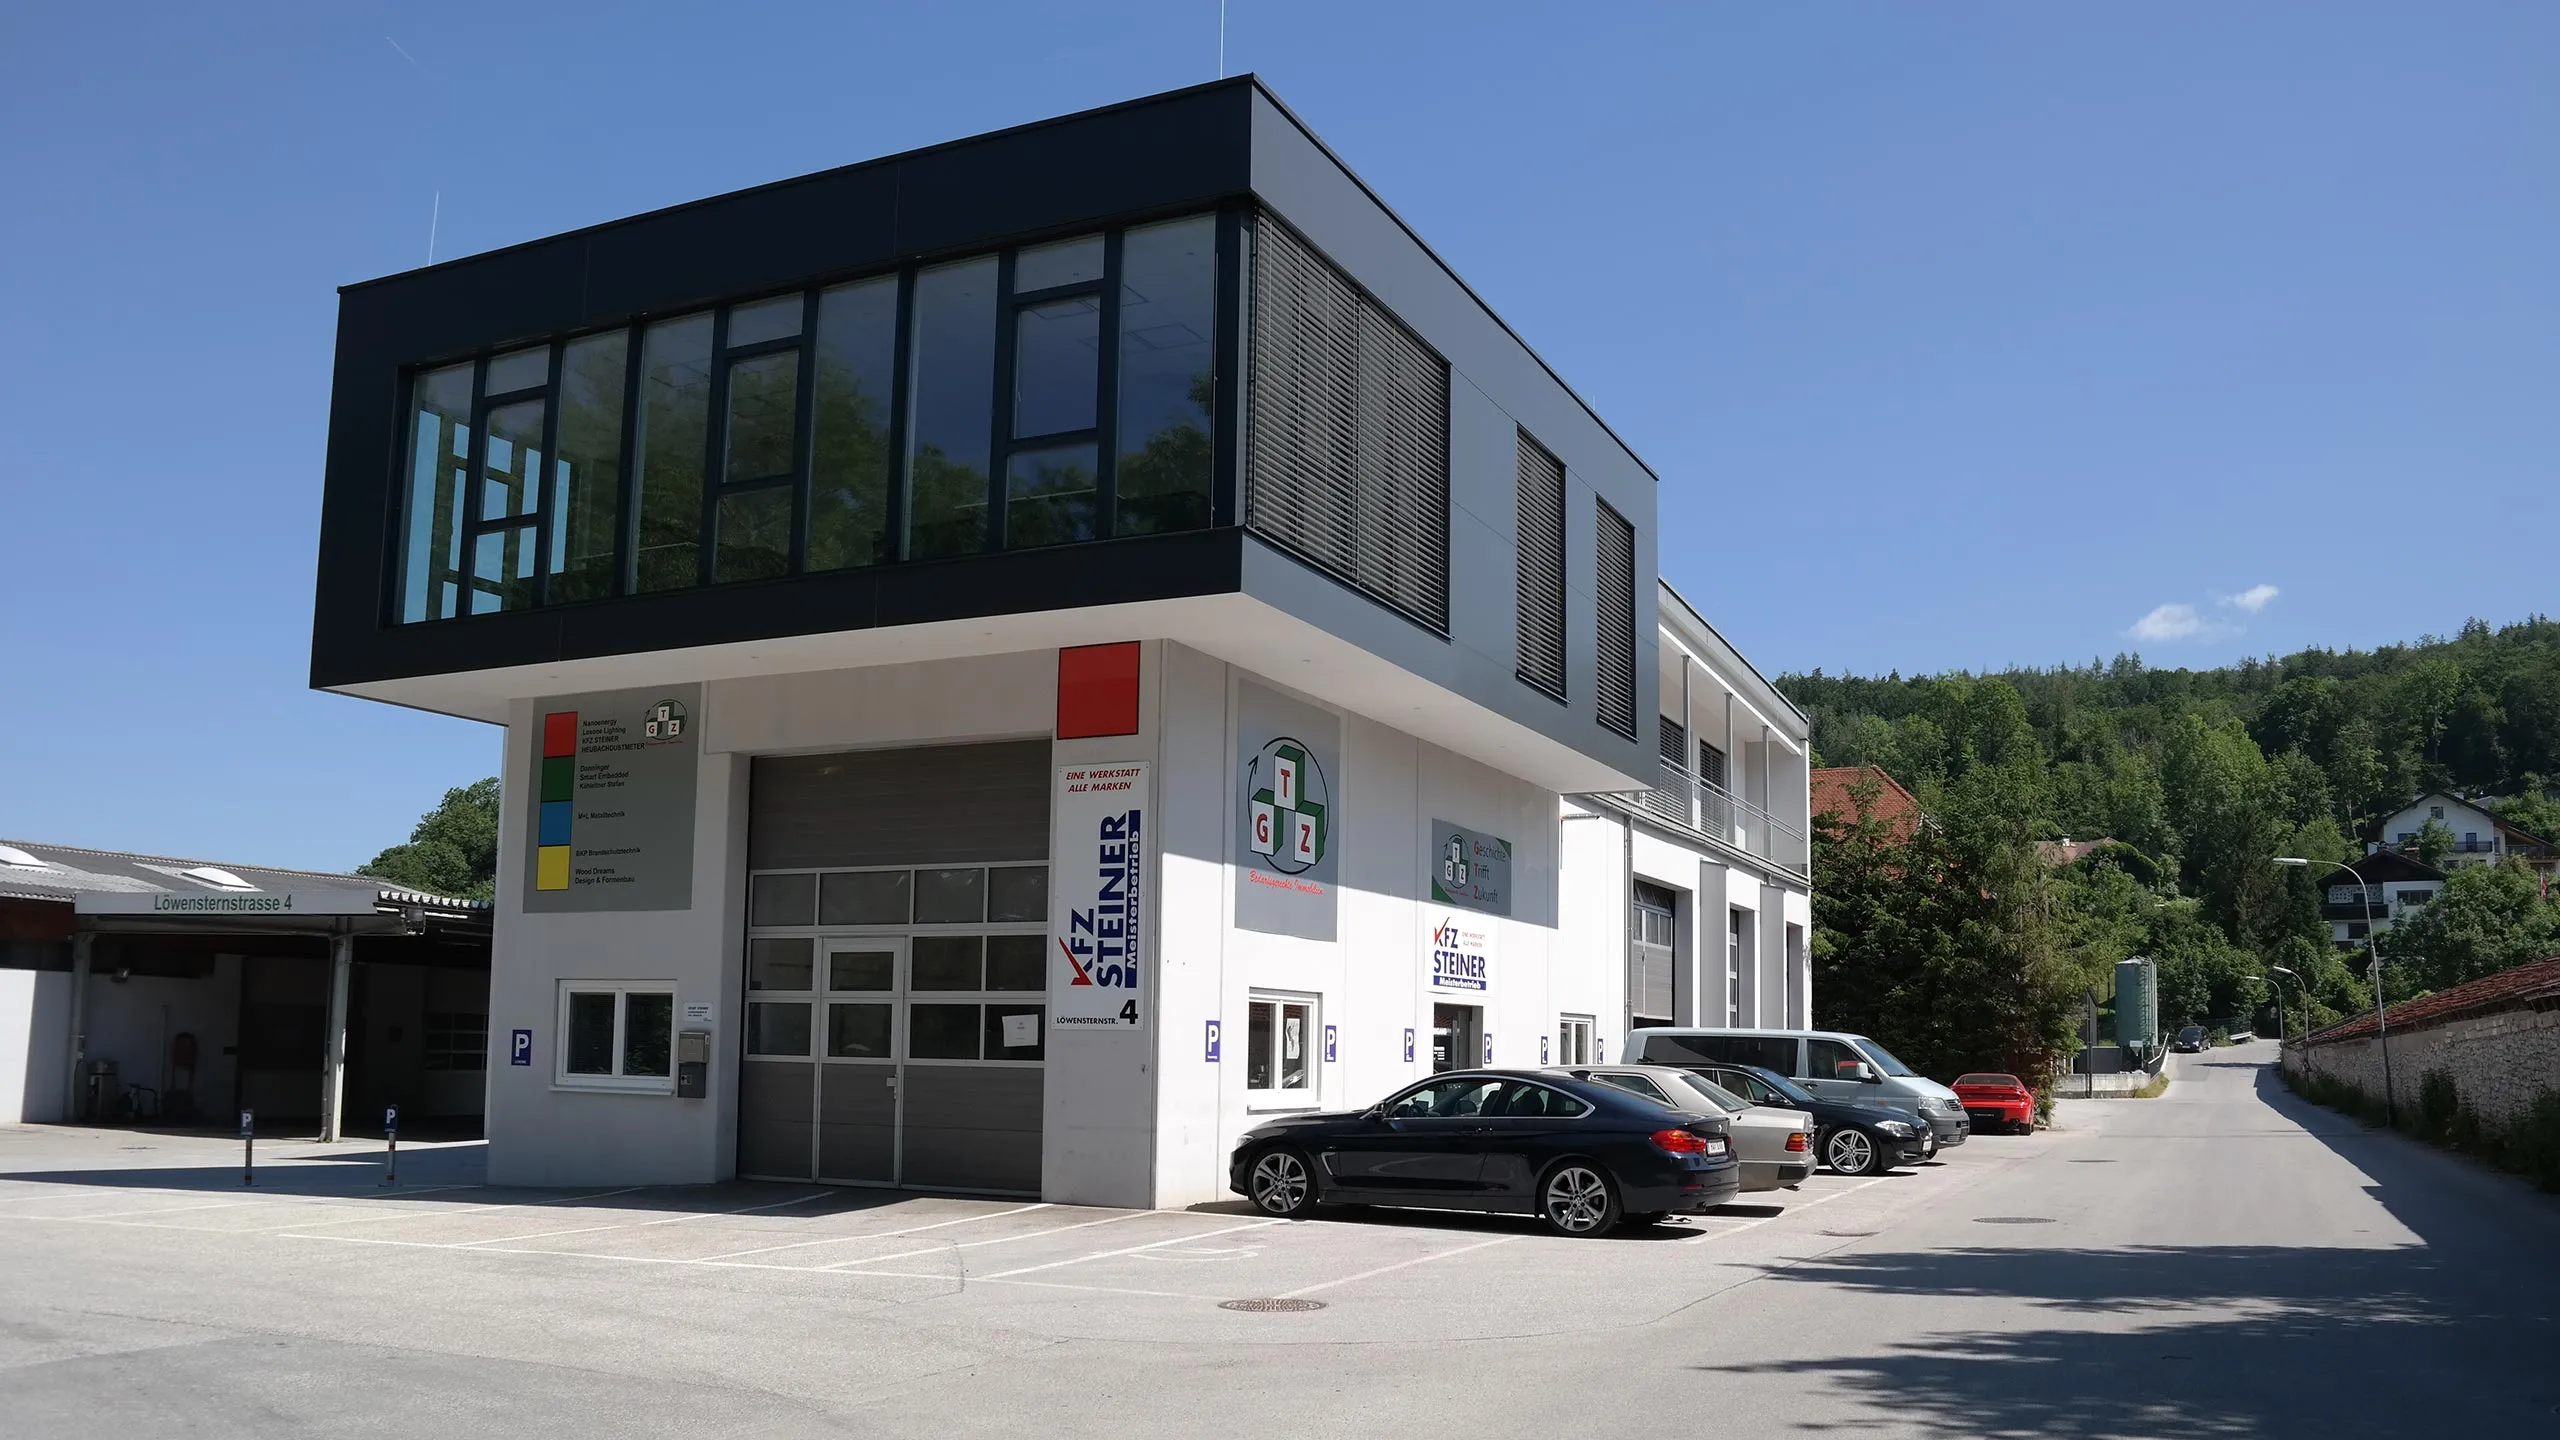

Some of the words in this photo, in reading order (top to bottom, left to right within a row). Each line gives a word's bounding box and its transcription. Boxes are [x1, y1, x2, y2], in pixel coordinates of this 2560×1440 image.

[661, 710, 667, 718] T
[594, 735, 619, 744] STEINER
[649, 725, 655, 734] G
[671, 724, 677, 733] Z
[1066, 771, 1086, 780] EINE
[1089, 768, 1141, 779] WERKSTATT
[1280, 768, 1291, 798] T
[1068, 783, 1089, 793] ALLE
[1091, 782, 1132, 792] MARKEN
[1256, 813, 1268, 844] G
[1300, 823, 1311, 853] Z
[1473, 840, 1506, 862] Geschichte
[575, 868, 592, 876] Wood
[593, 867, 615, 875] Dreams
[575, 877, 595, 886] Design
[596, 876, 601, 884] &
[1473, 863, 1490, 881] Trifft
[154, 894, 280, 911] Löwensternstrasse
[284, 894, 292, 911] 4
[1096, 811, 1128, 988] STEINER
[1126, 830, 1140, 969] Meisterbetrieb
[1473, 884, 1499, 904] Zukunft
[1434, 917, 1459, 949] KFZ
[1058, 908, 1095, 987] KFZ
[1433, 949, 1486, 979] STEINER
[1440, 976, 1482, 990] Meisterbetrieb
[1056, 1016, 1119, 1025] LÖWENSTERNSTR.
[1119, 999, 1139, 1025] 4
[515, 1033, 529, 1057] P
[1207, 1024, 1219, 1053] P
[1326, 1029, 1336, 1053] P
[1405, 1032, 1414, 1055] P
[1485, 1036, 1492, 1058] P
[242, 1113, 252, 1127] P
[386, 1108, 396, 1124] P
